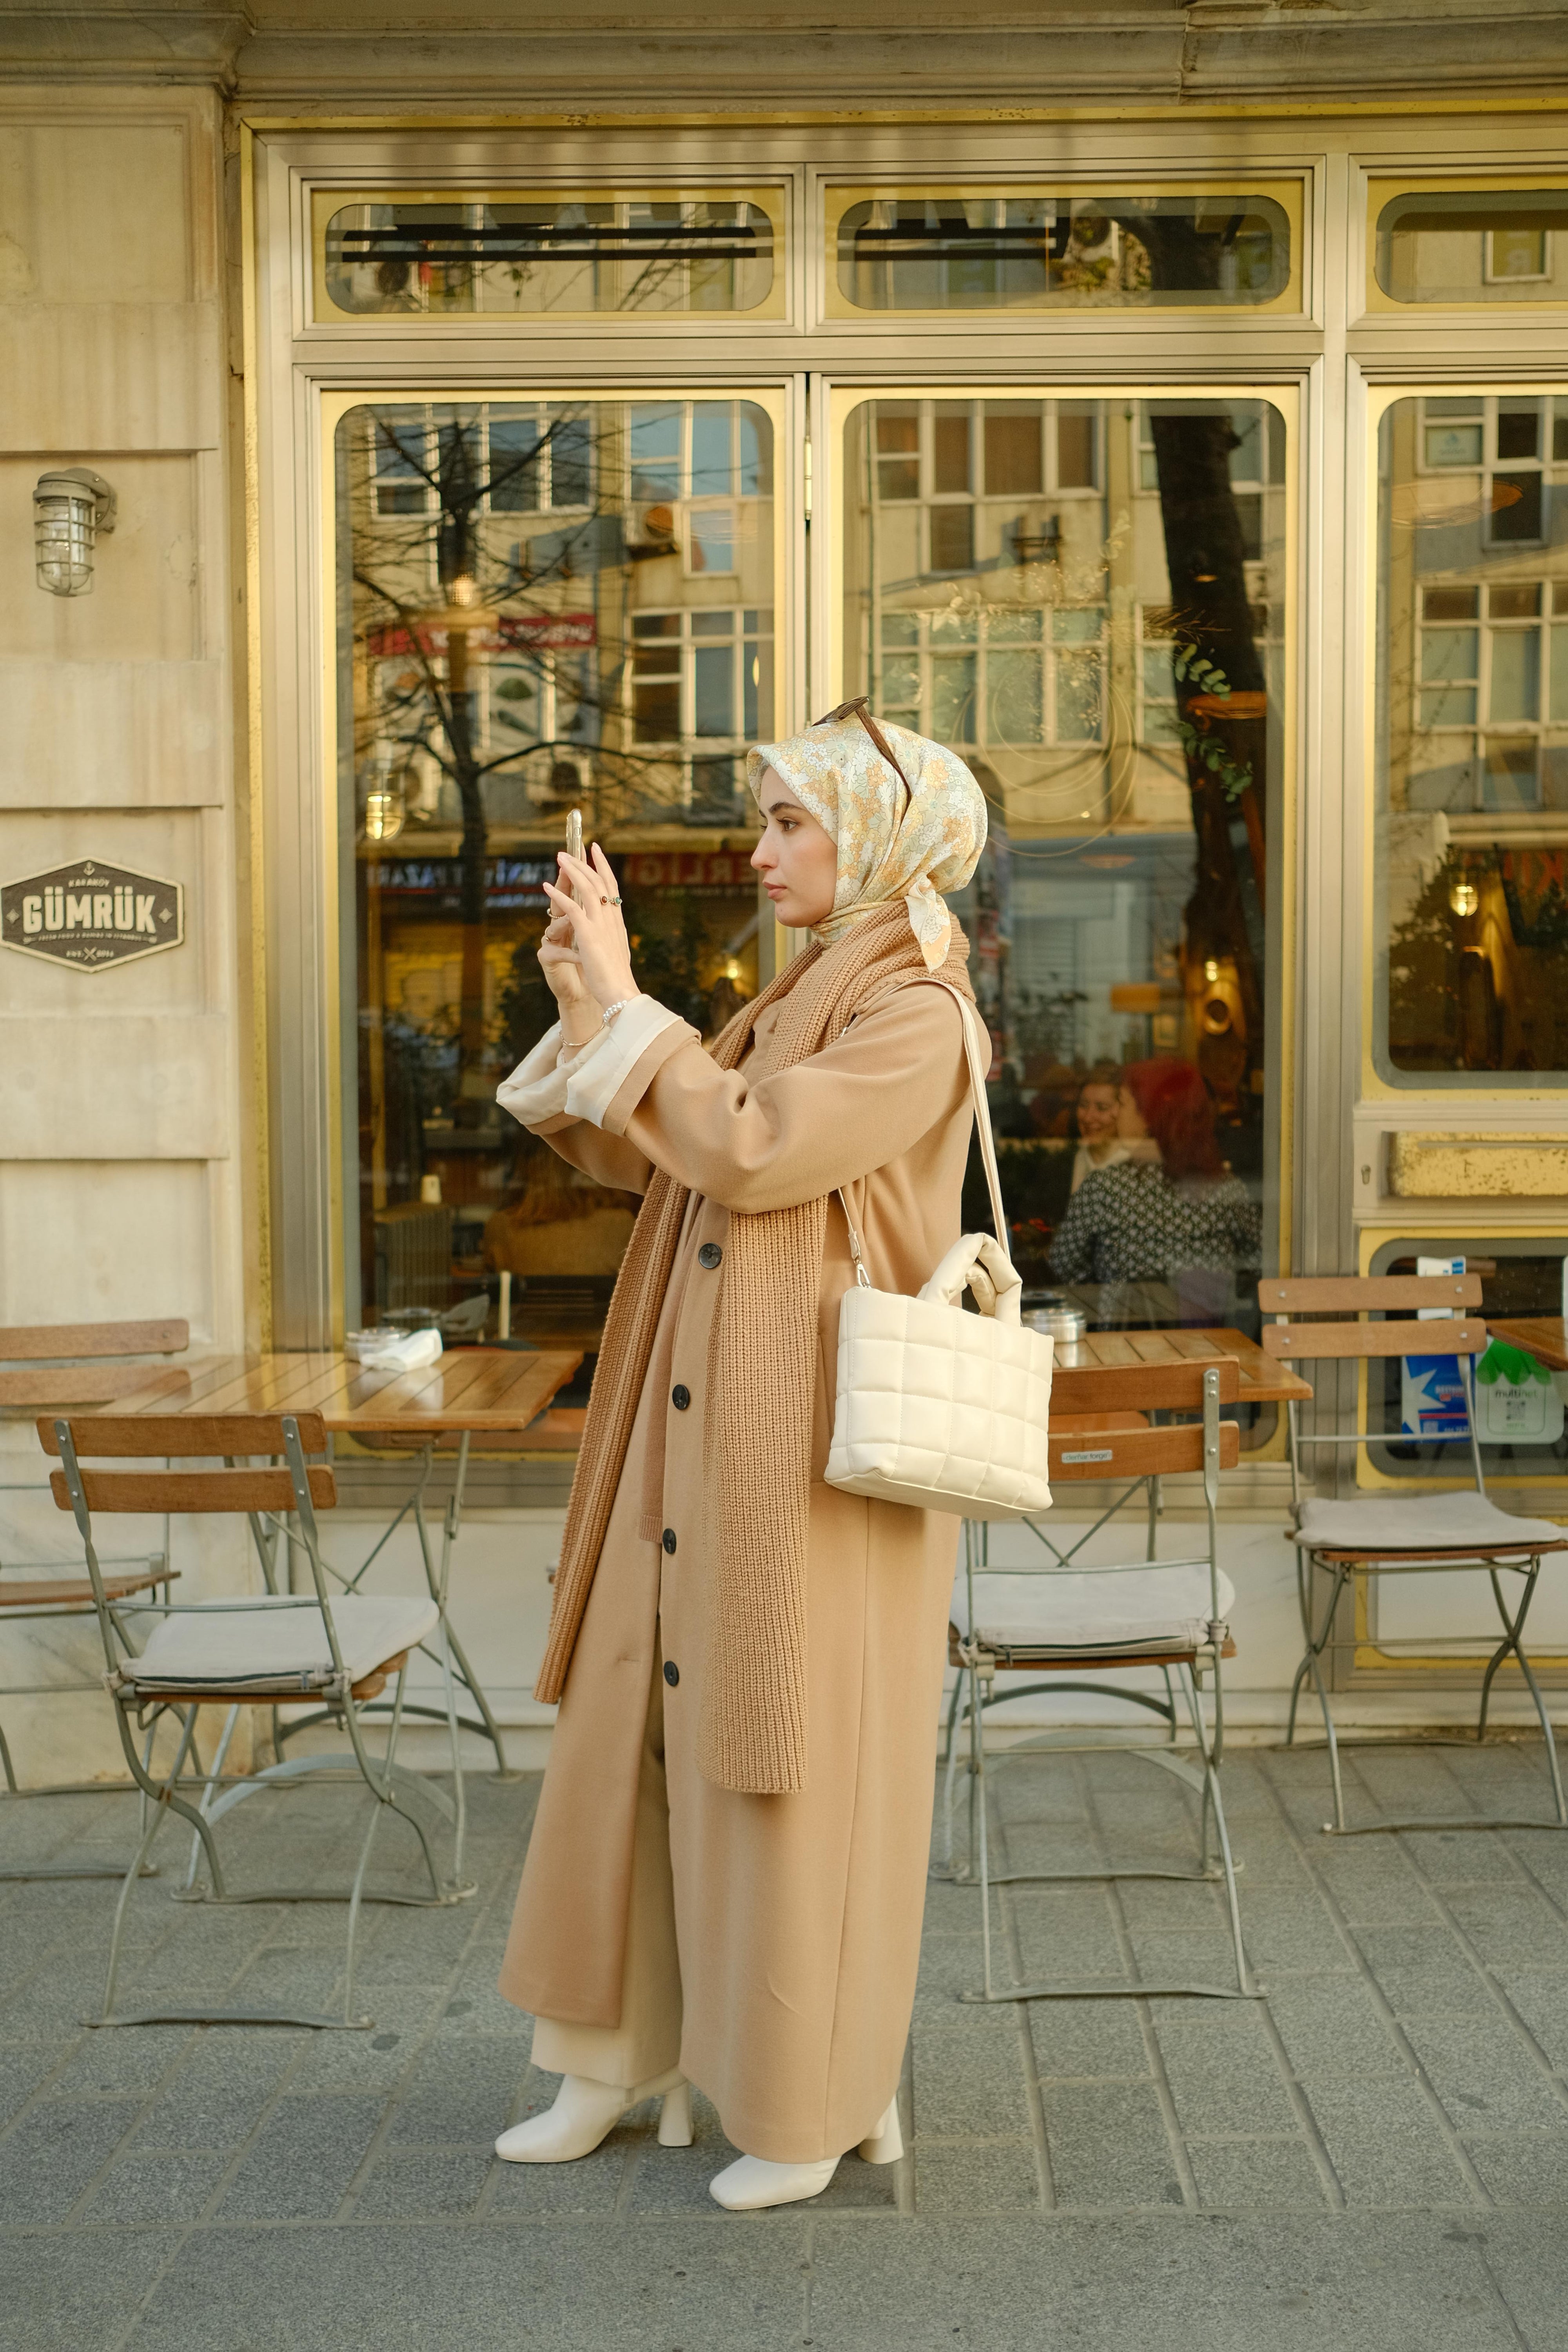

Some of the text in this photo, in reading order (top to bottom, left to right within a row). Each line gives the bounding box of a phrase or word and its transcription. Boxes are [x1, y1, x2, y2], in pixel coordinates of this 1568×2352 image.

[68, 877, 110, 888] KARAKÖY
[23, 886, 156, 934] GÜMRÜK
[1495, 1388, 1538, 1398] multinet
